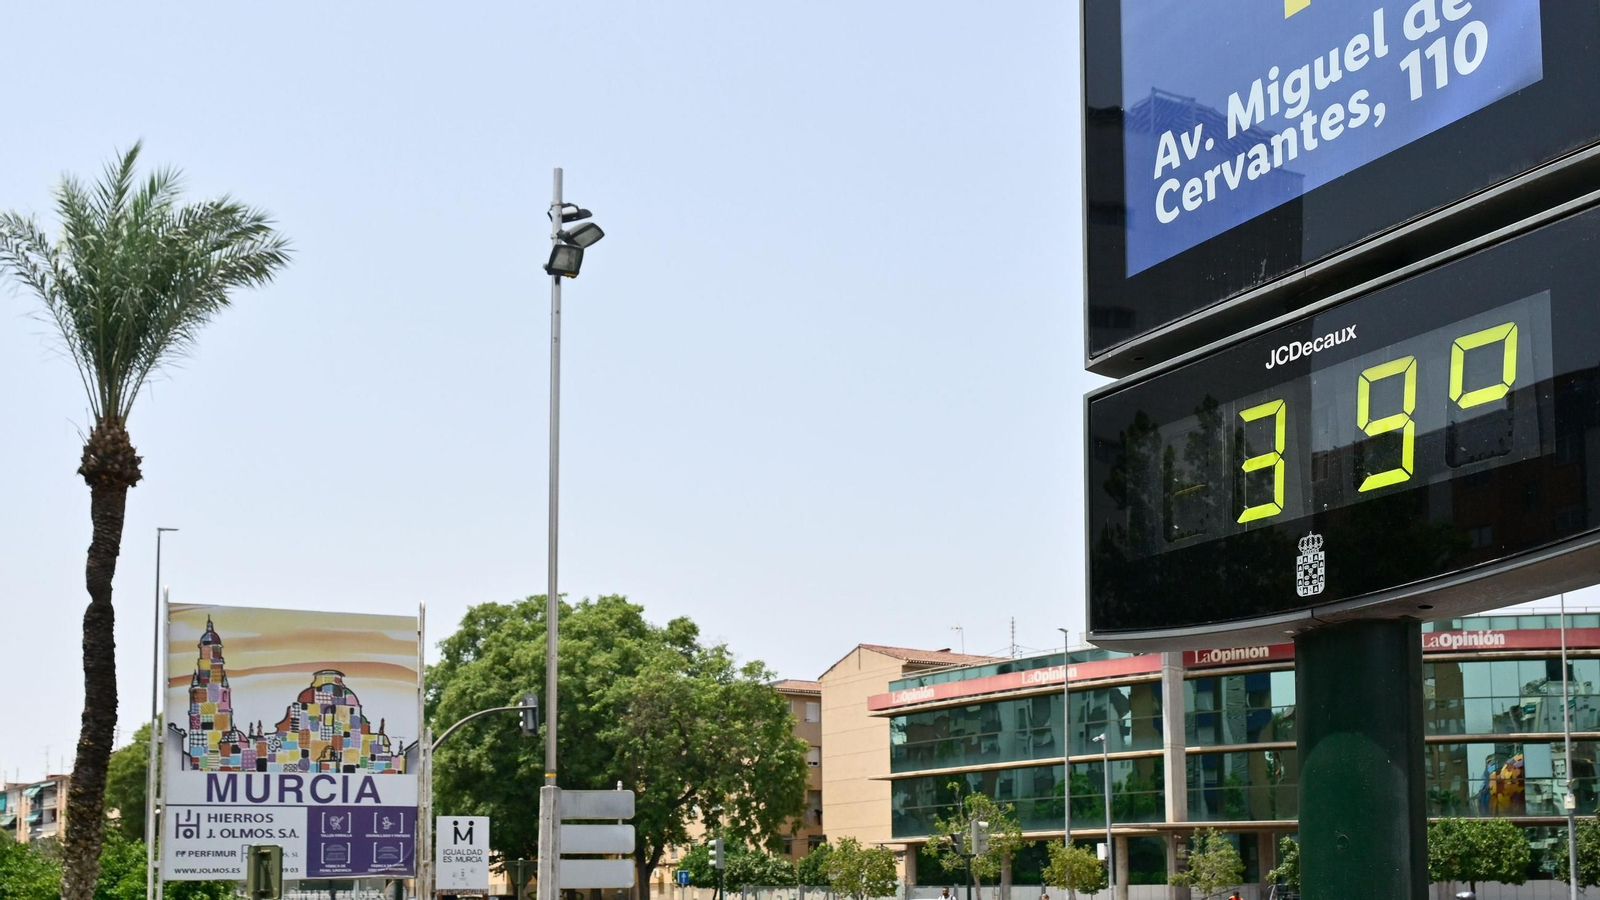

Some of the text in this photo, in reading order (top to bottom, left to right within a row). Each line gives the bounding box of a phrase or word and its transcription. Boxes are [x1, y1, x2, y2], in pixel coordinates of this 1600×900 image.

[1153, 0, 1473, 180] Av. Miguel de
[1154, 20, 1489, 225] Cervantes, 110
[1265, 324, 1357, 370] JCDecaux
[206, 773, 382, 804] MURCIA
[206, 828, 216, 839] J.
[278, 828, 300, 839] S.A.
[207, 813, 274, 823] HIERROS
